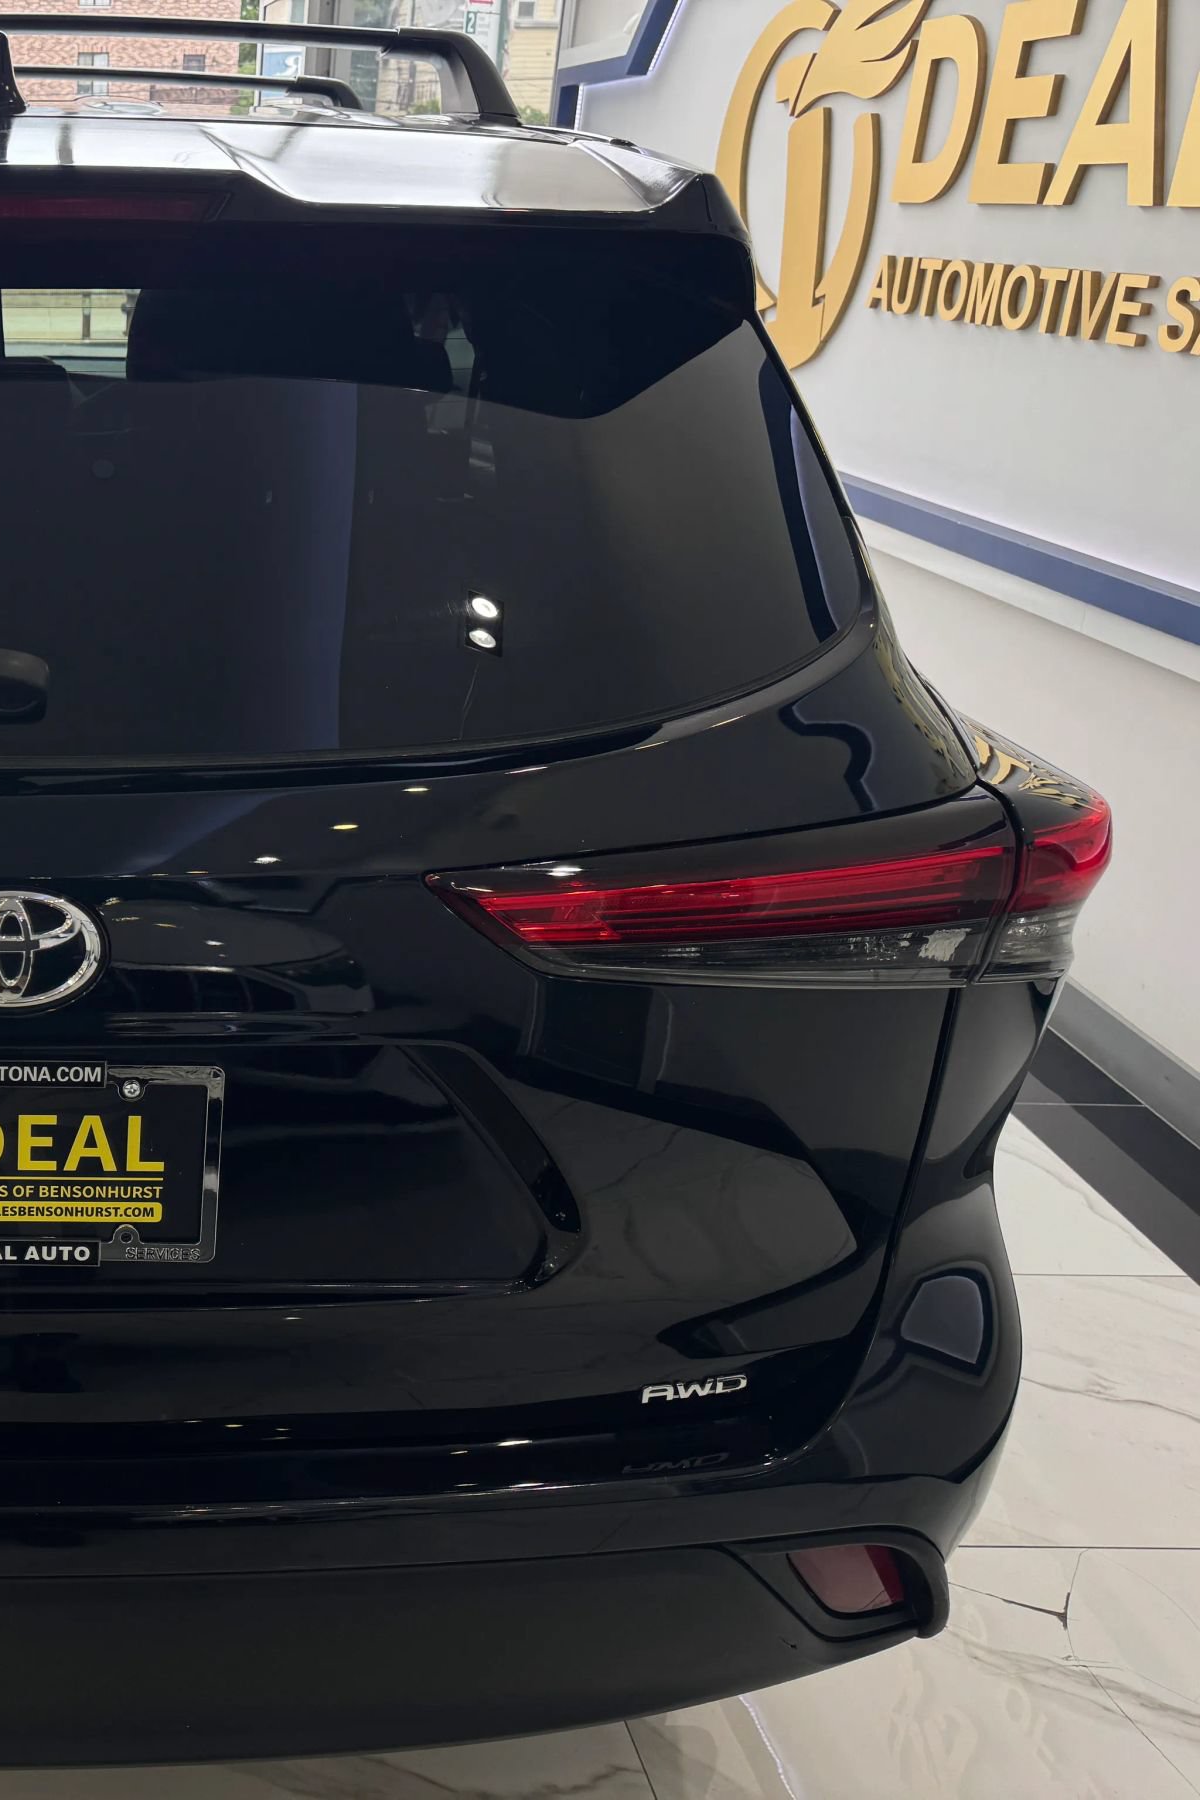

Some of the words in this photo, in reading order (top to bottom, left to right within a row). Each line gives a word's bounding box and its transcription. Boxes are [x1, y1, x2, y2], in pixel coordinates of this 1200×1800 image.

[867, 254, 1160, 347] AUTOMOTIVE
[12, 1184, 36, 1199] OF
[38, 1185, 164, 1200] BENSONHURST
[24, 1245, 91, 1262] AUTO
[125, 1247, 201, 1262] SERVICES
[641, 1374, 748, 1404] AWD
